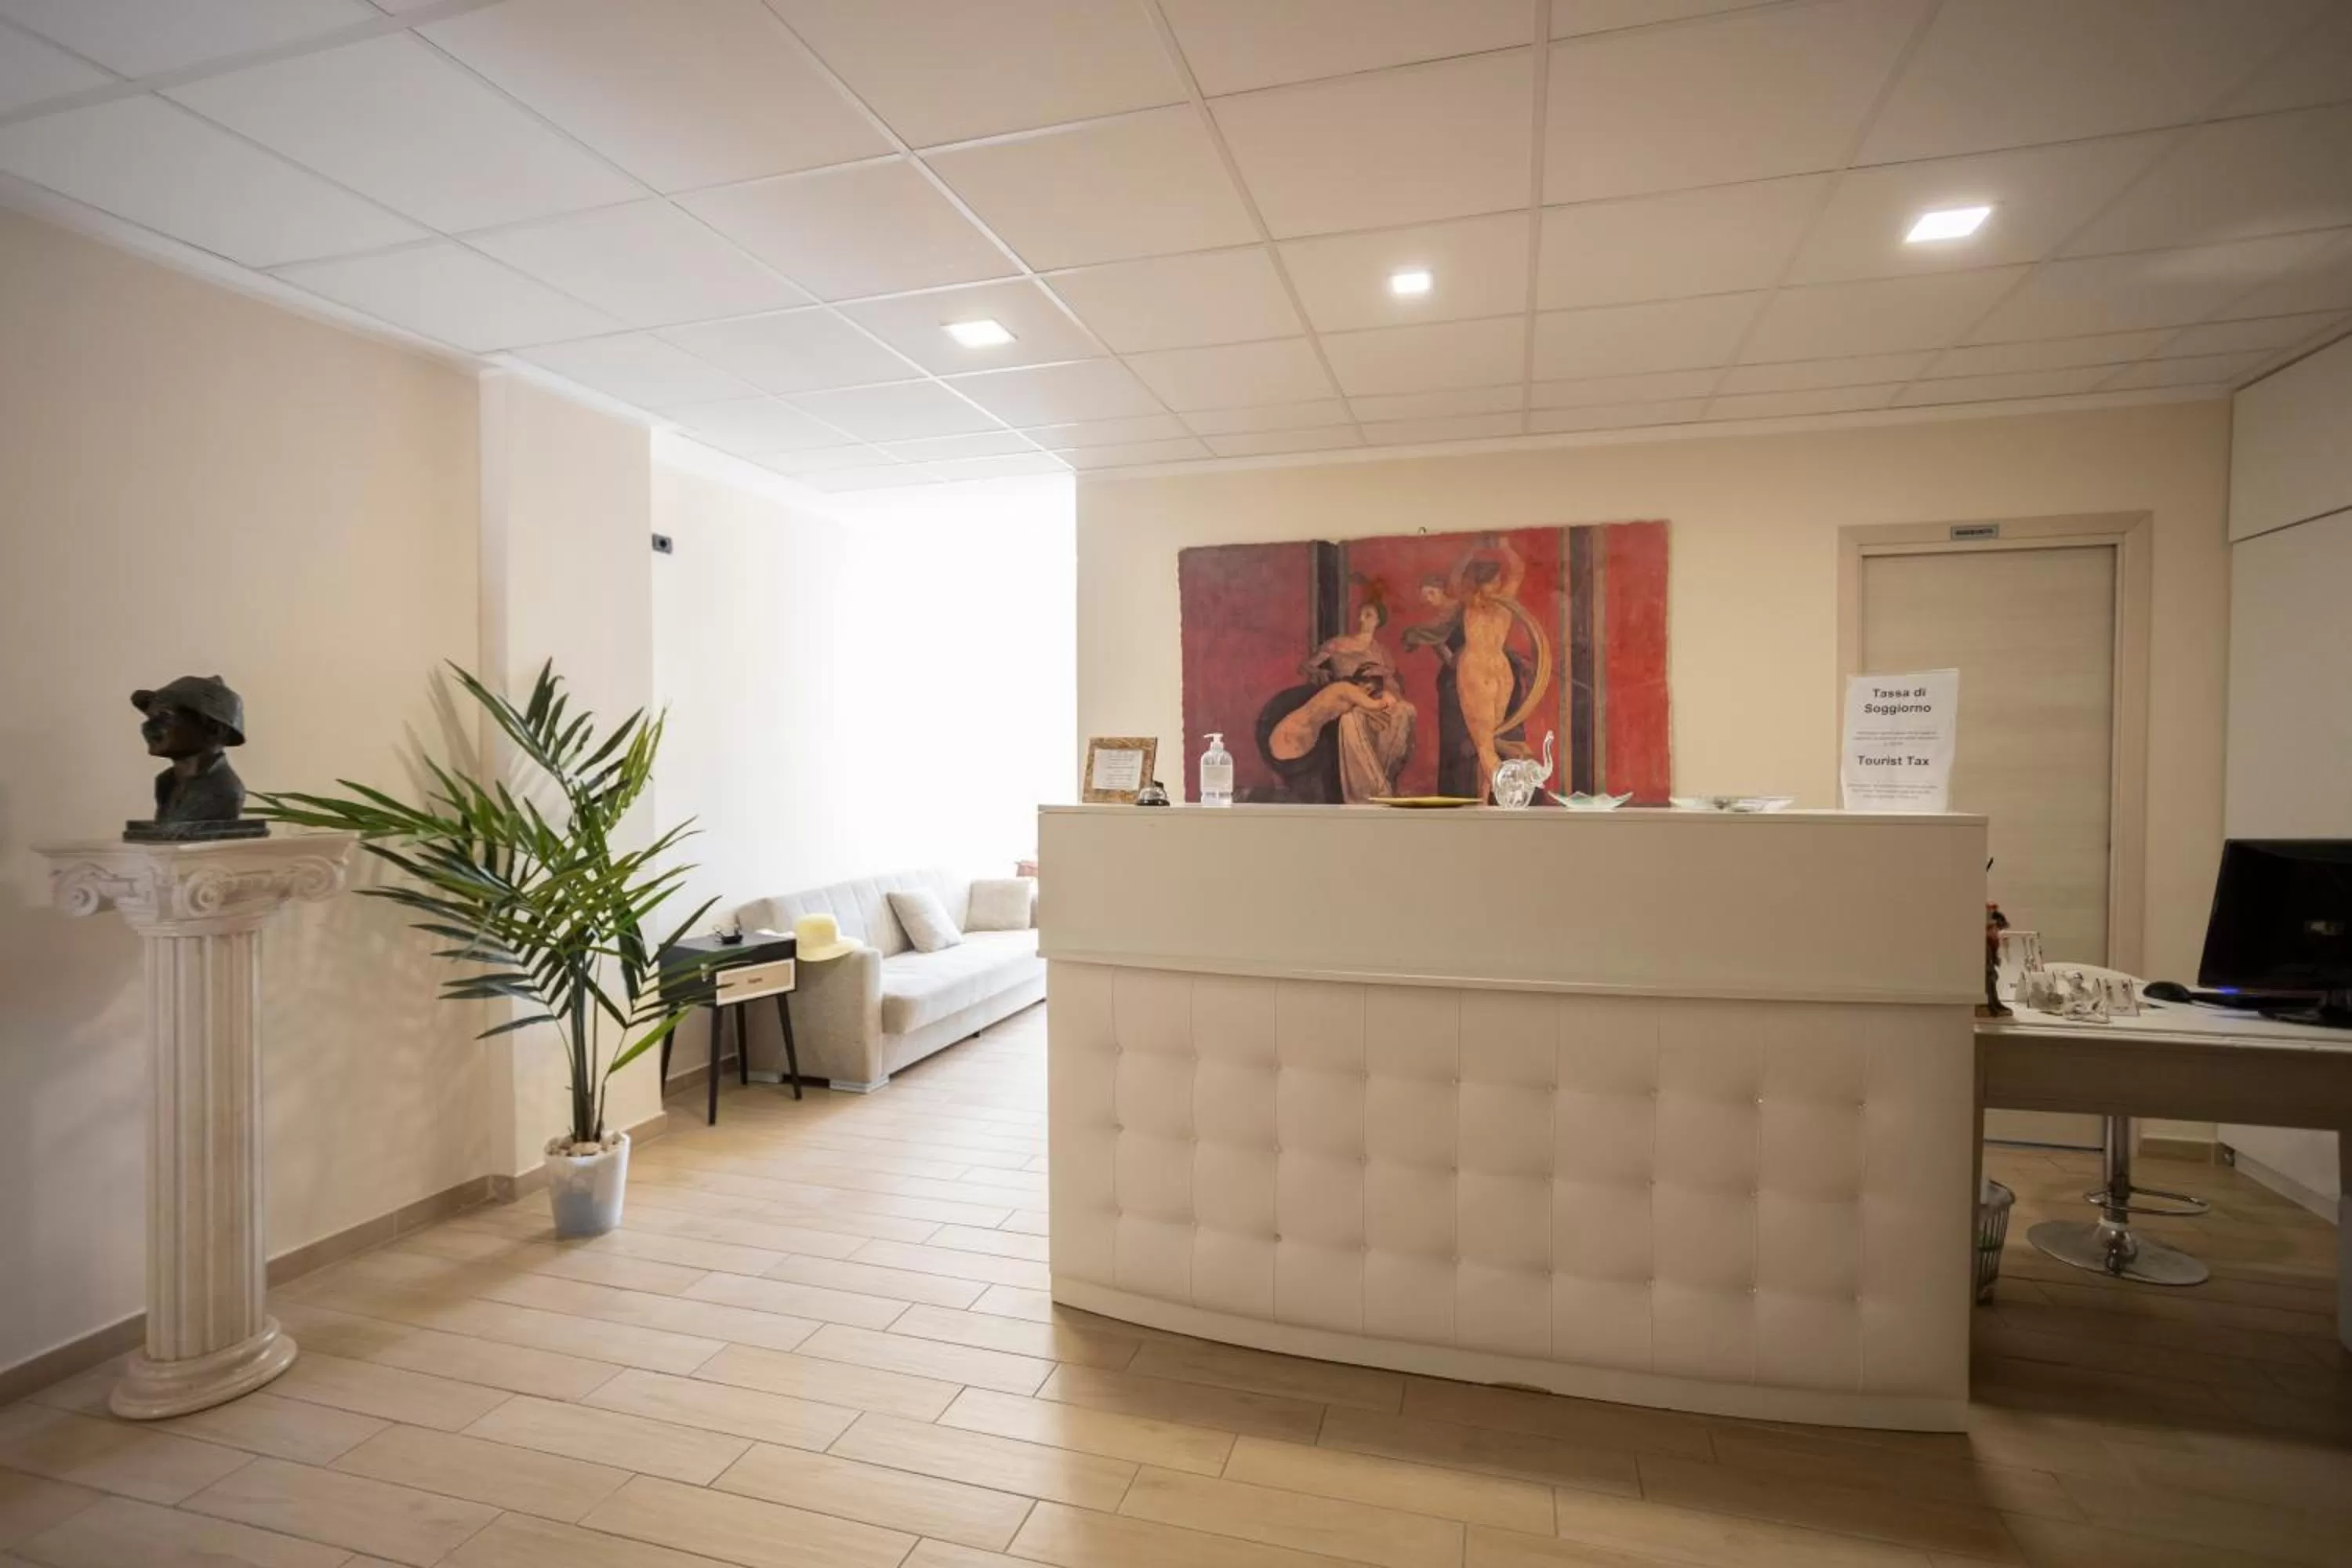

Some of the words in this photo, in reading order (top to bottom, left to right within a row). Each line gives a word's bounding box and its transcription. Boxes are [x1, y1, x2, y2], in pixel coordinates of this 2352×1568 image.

[1873, 688, 1910, 698] Tassa
[1914, 688, 1926, 697] di
[1864, 703, 1932, 715] Soggiorno
[1858, 755, 1902, 766] Tourist
[1907, 755, 1929, 766] Tax
